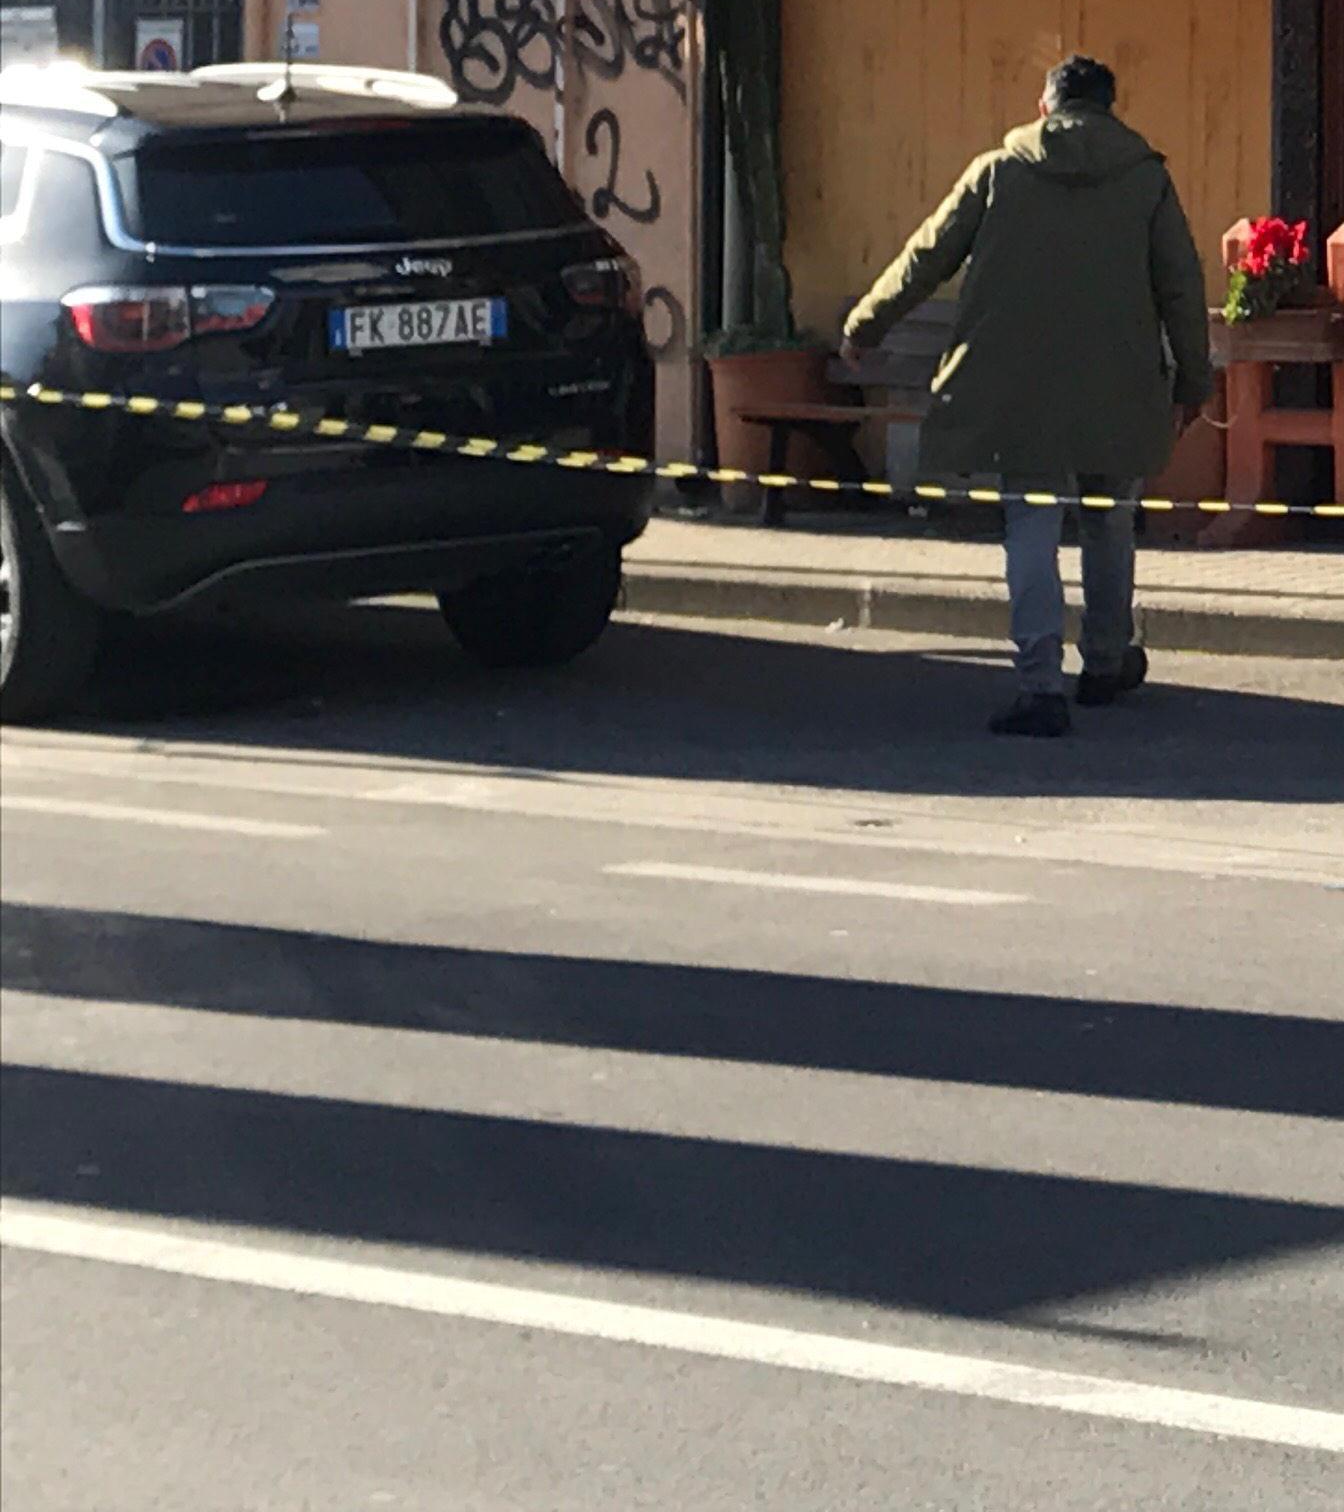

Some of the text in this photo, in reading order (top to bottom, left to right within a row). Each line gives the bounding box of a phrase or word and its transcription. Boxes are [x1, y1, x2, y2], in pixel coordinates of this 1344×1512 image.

[395, 257, 452, 277] Jeep
[349, 302, 489, 345] FK 887AE
